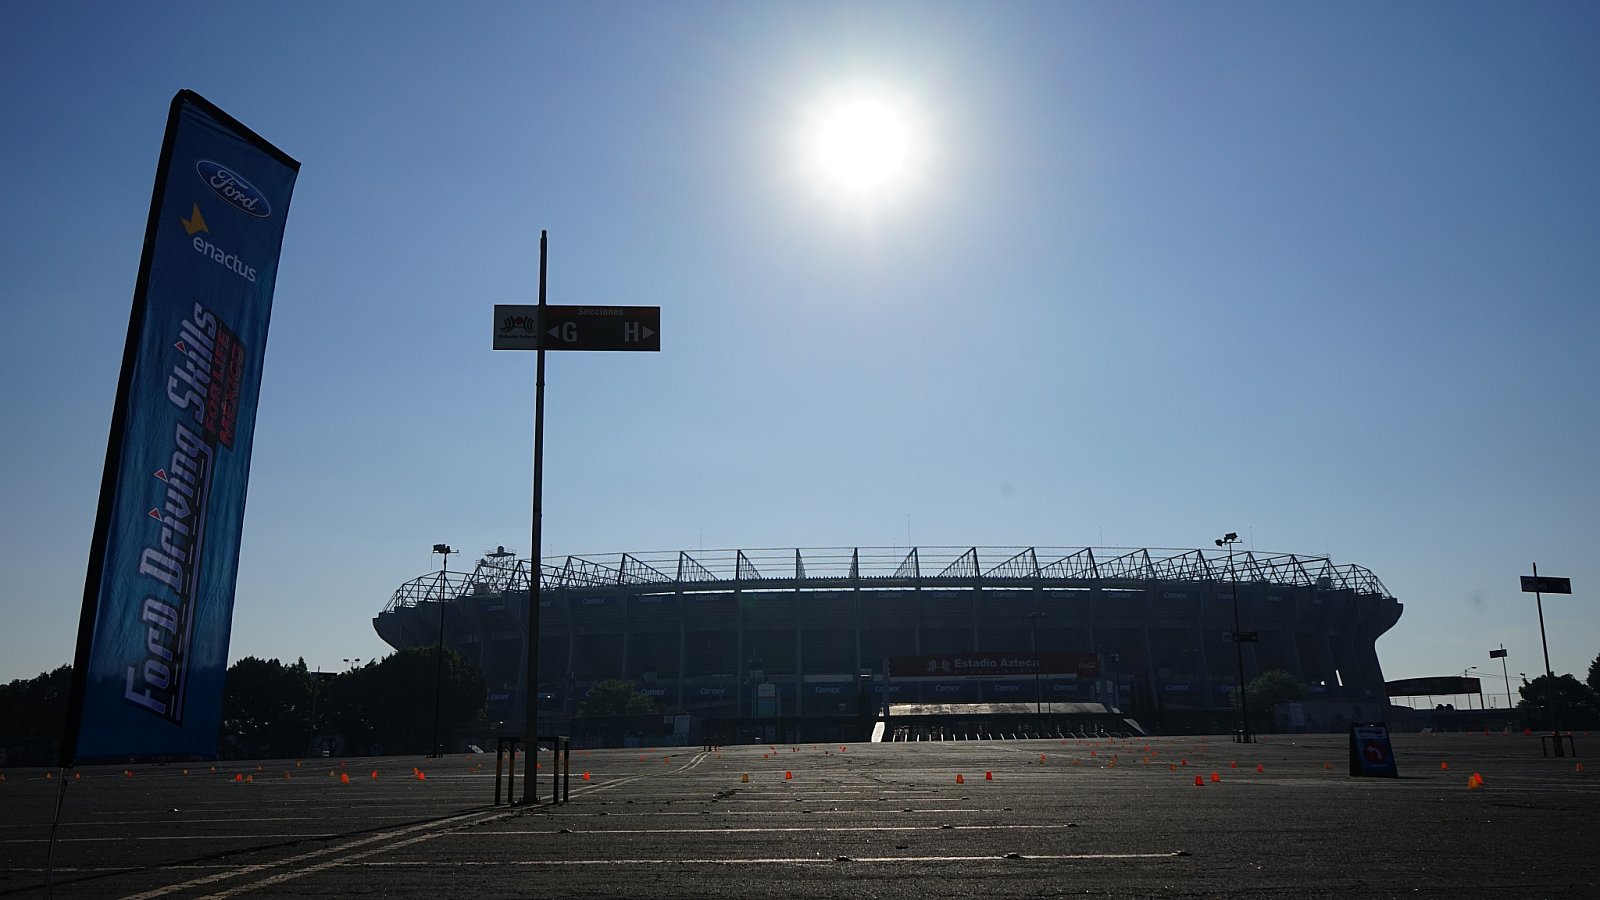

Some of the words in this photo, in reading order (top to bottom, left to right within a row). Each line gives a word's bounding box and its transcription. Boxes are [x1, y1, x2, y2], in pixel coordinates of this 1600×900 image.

[192, 235, 257, 283] enactus
[577, 306, 625, 317] Secciones
[562, 321, 578, 343] G
[624, 321, 640, 343] H
[167, 301, 217, 421] Skills
[212, 328, 231, 378] LIFE
[204, 382, 221, 433] FOR
[139, 422, 213, 595] Driving
[954, 658, 998, 669] Estadio
[1000, 658, 1040, 668] Azteca
[936, 684, 961, 692] Comex
[994, 684, 1021, 692] Comex
